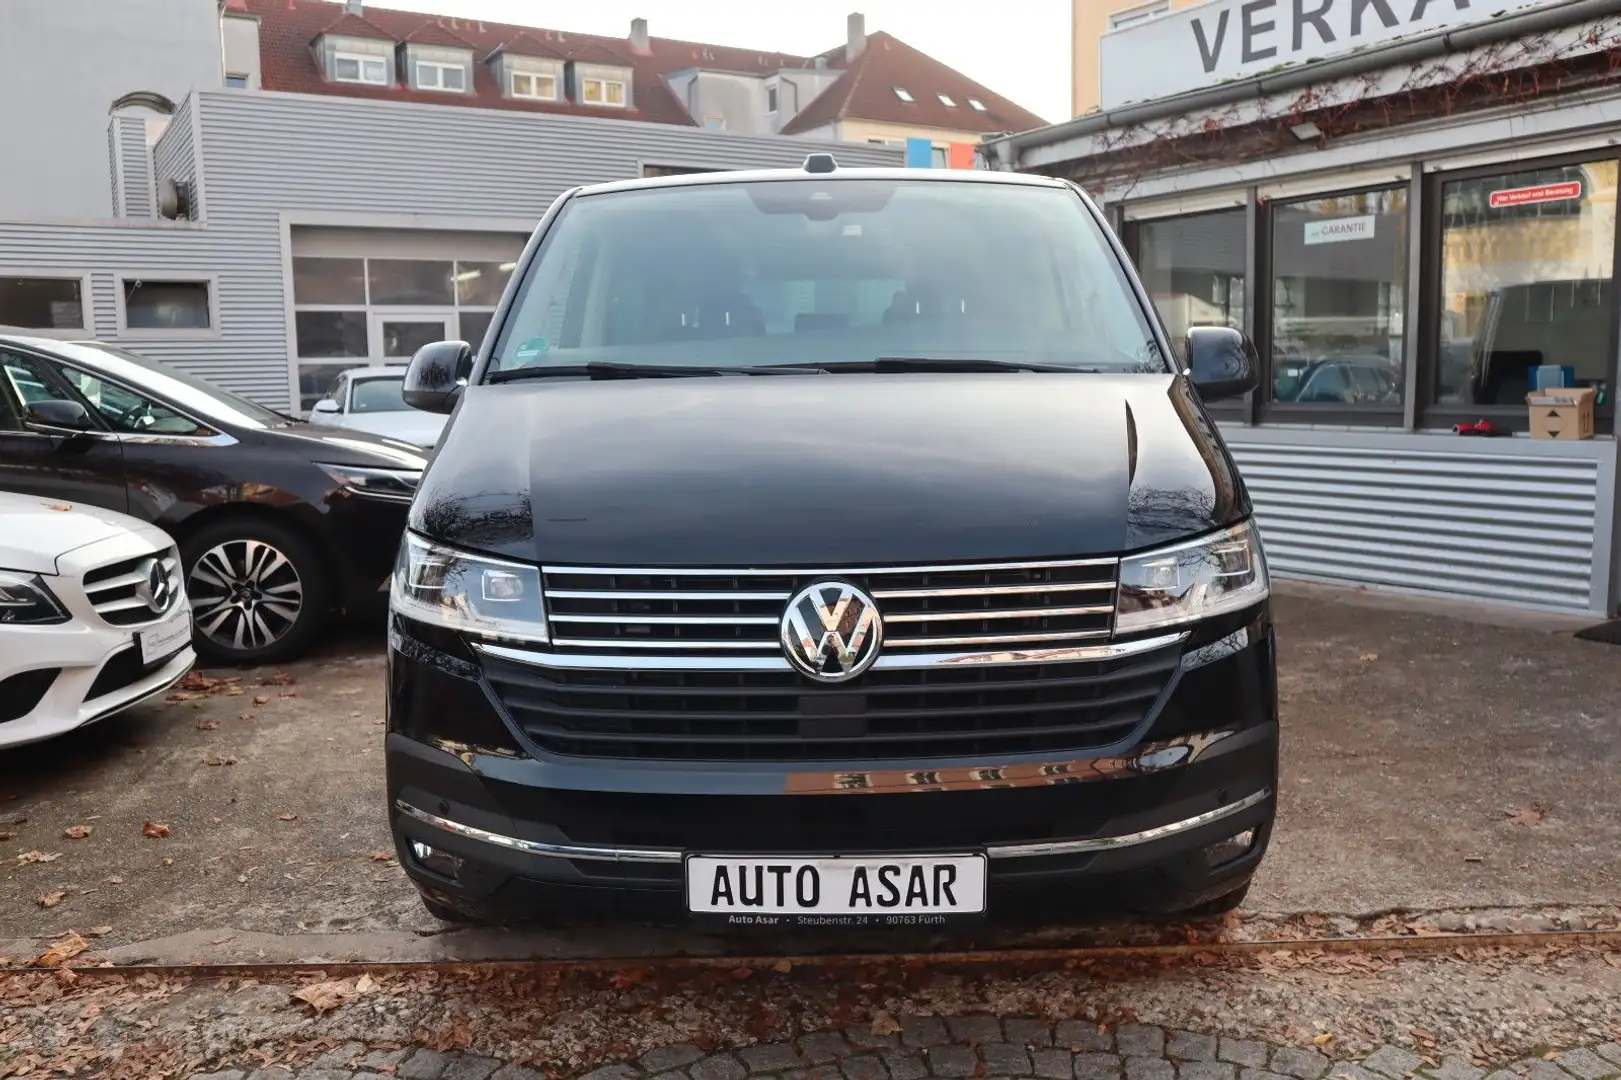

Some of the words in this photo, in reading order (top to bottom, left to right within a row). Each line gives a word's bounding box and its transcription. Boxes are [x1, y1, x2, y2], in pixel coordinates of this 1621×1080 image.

[1190, 0, 1471, 74] VERK
[711, 864, 820, 907] AUTO
[849, 864, 957, 907] ASAR
[728, 915, 753, 924] Auto
[755, 915, 779, 925] Asar
[797, 915, 853, 925] Steubenstr.
[856, 916, 868, 925] 24
[886, 915, 916, 925] 90763
